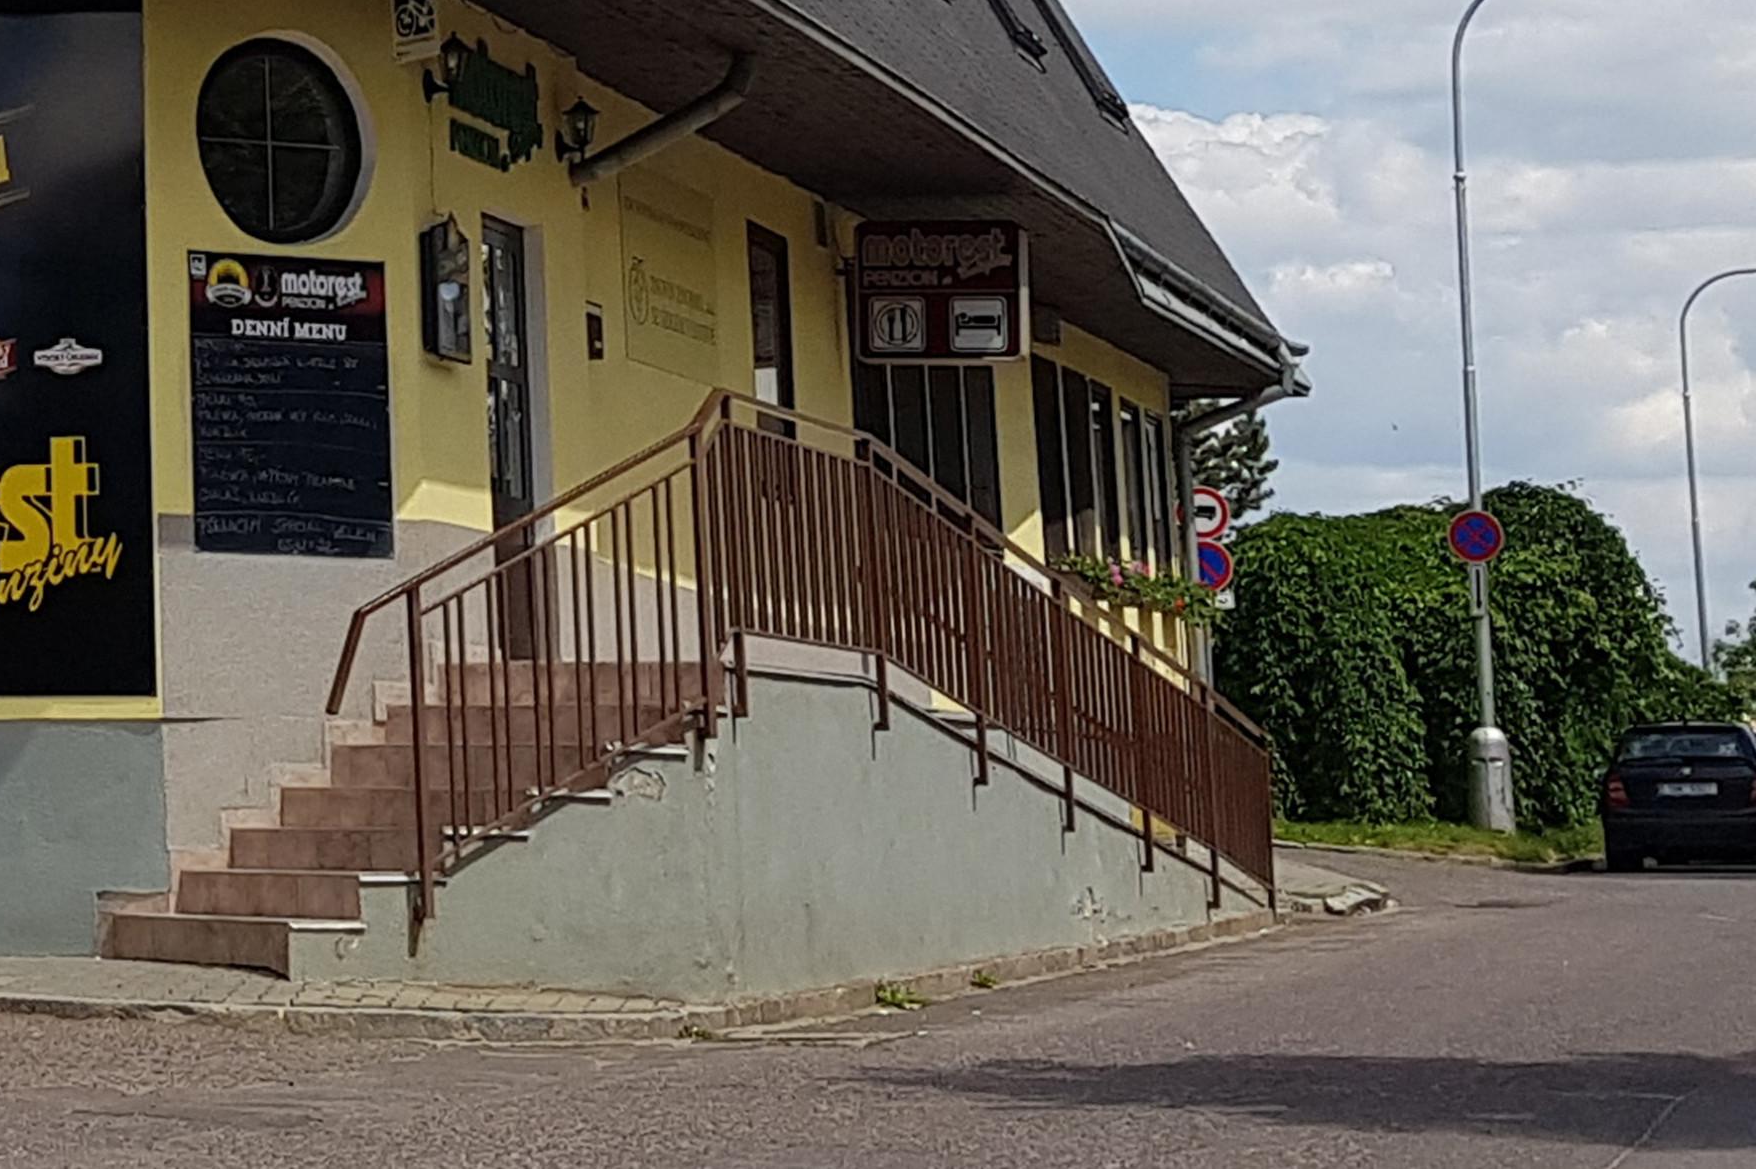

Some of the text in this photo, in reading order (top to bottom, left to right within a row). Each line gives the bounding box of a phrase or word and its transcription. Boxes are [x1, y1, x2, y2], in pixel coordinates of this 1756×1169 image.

[862, 227, 1008, 267] motorest
[280, 269, 364, 297] motorest
[231, 316, 348, 341] DENNÍ MENU
